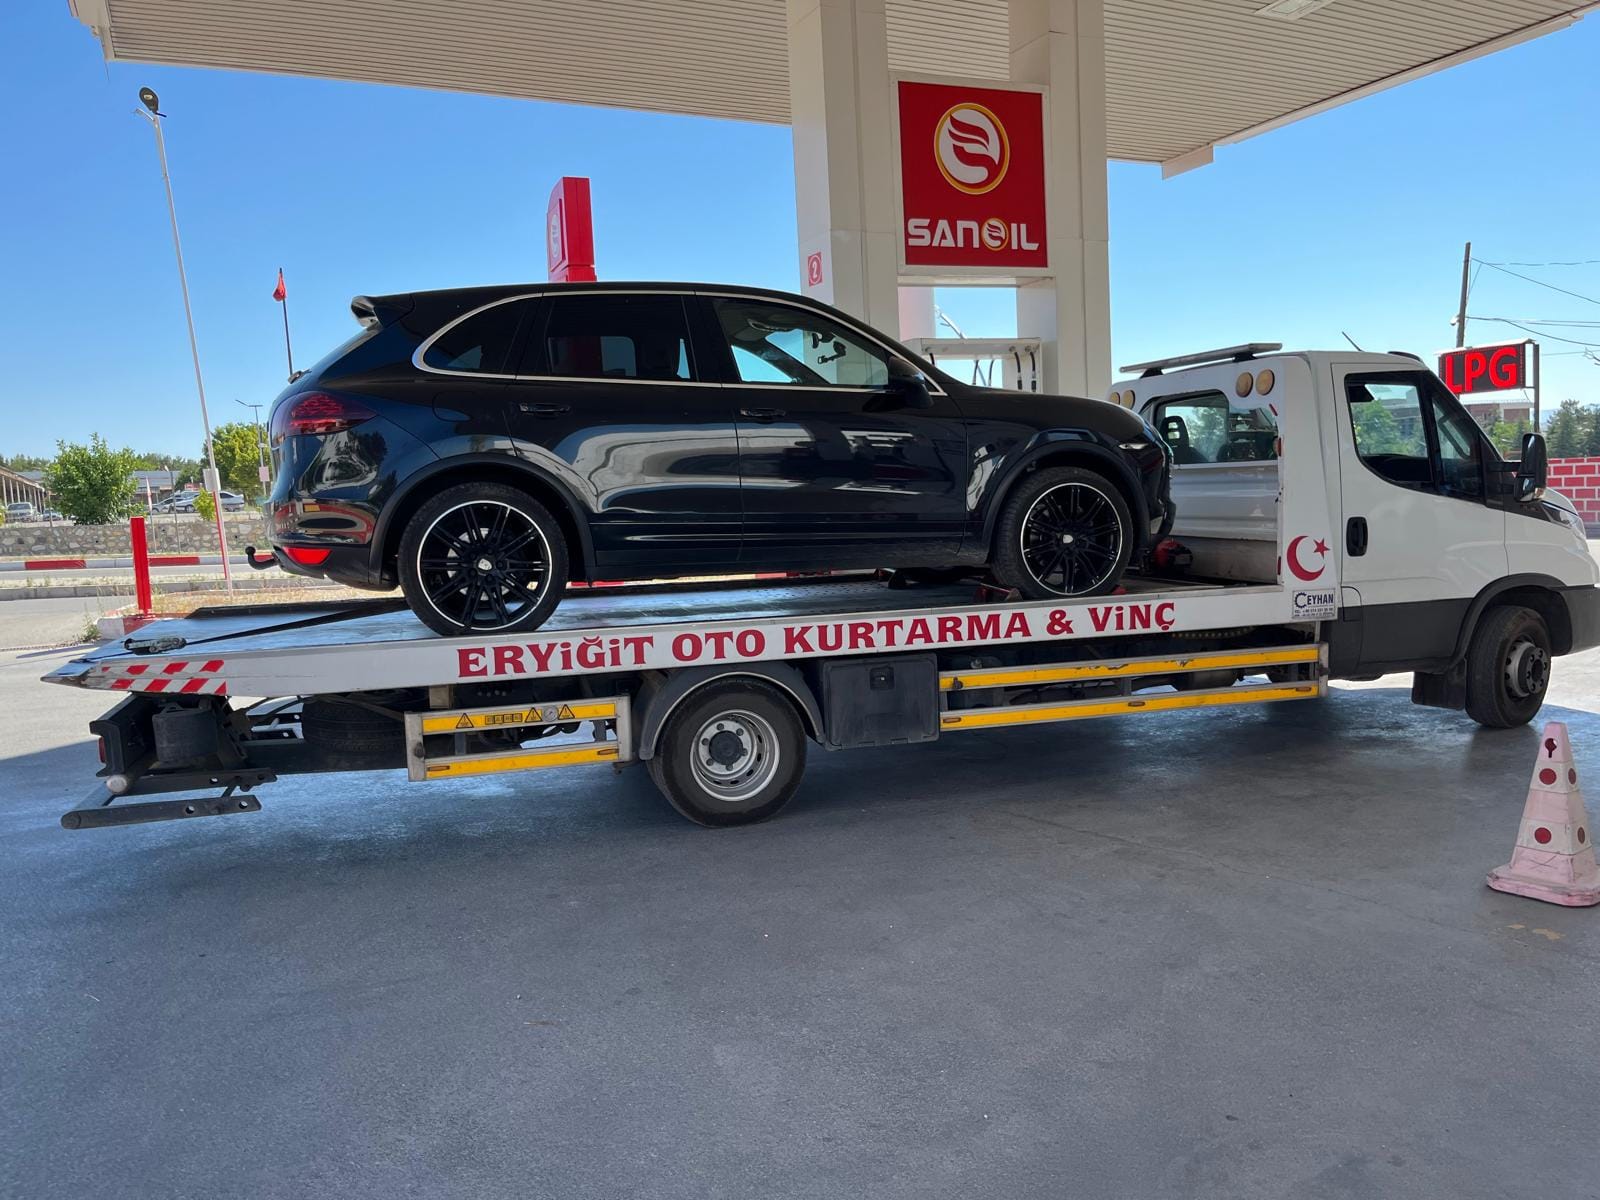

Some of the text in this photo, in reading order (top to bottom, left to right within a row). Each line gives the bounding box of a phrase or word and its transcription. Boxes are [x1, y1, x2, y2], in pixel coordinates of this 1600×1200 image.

[812, 260, 818, 279] 2
[1445, 346, 1518, 394] LPG
[1294, 592, 1334, 609] CEYHAN
[671, 629, 767, 662] OTO
[783, 611, 1032, 655] KURTARMA
[1046, 609, 1074, 636] &
